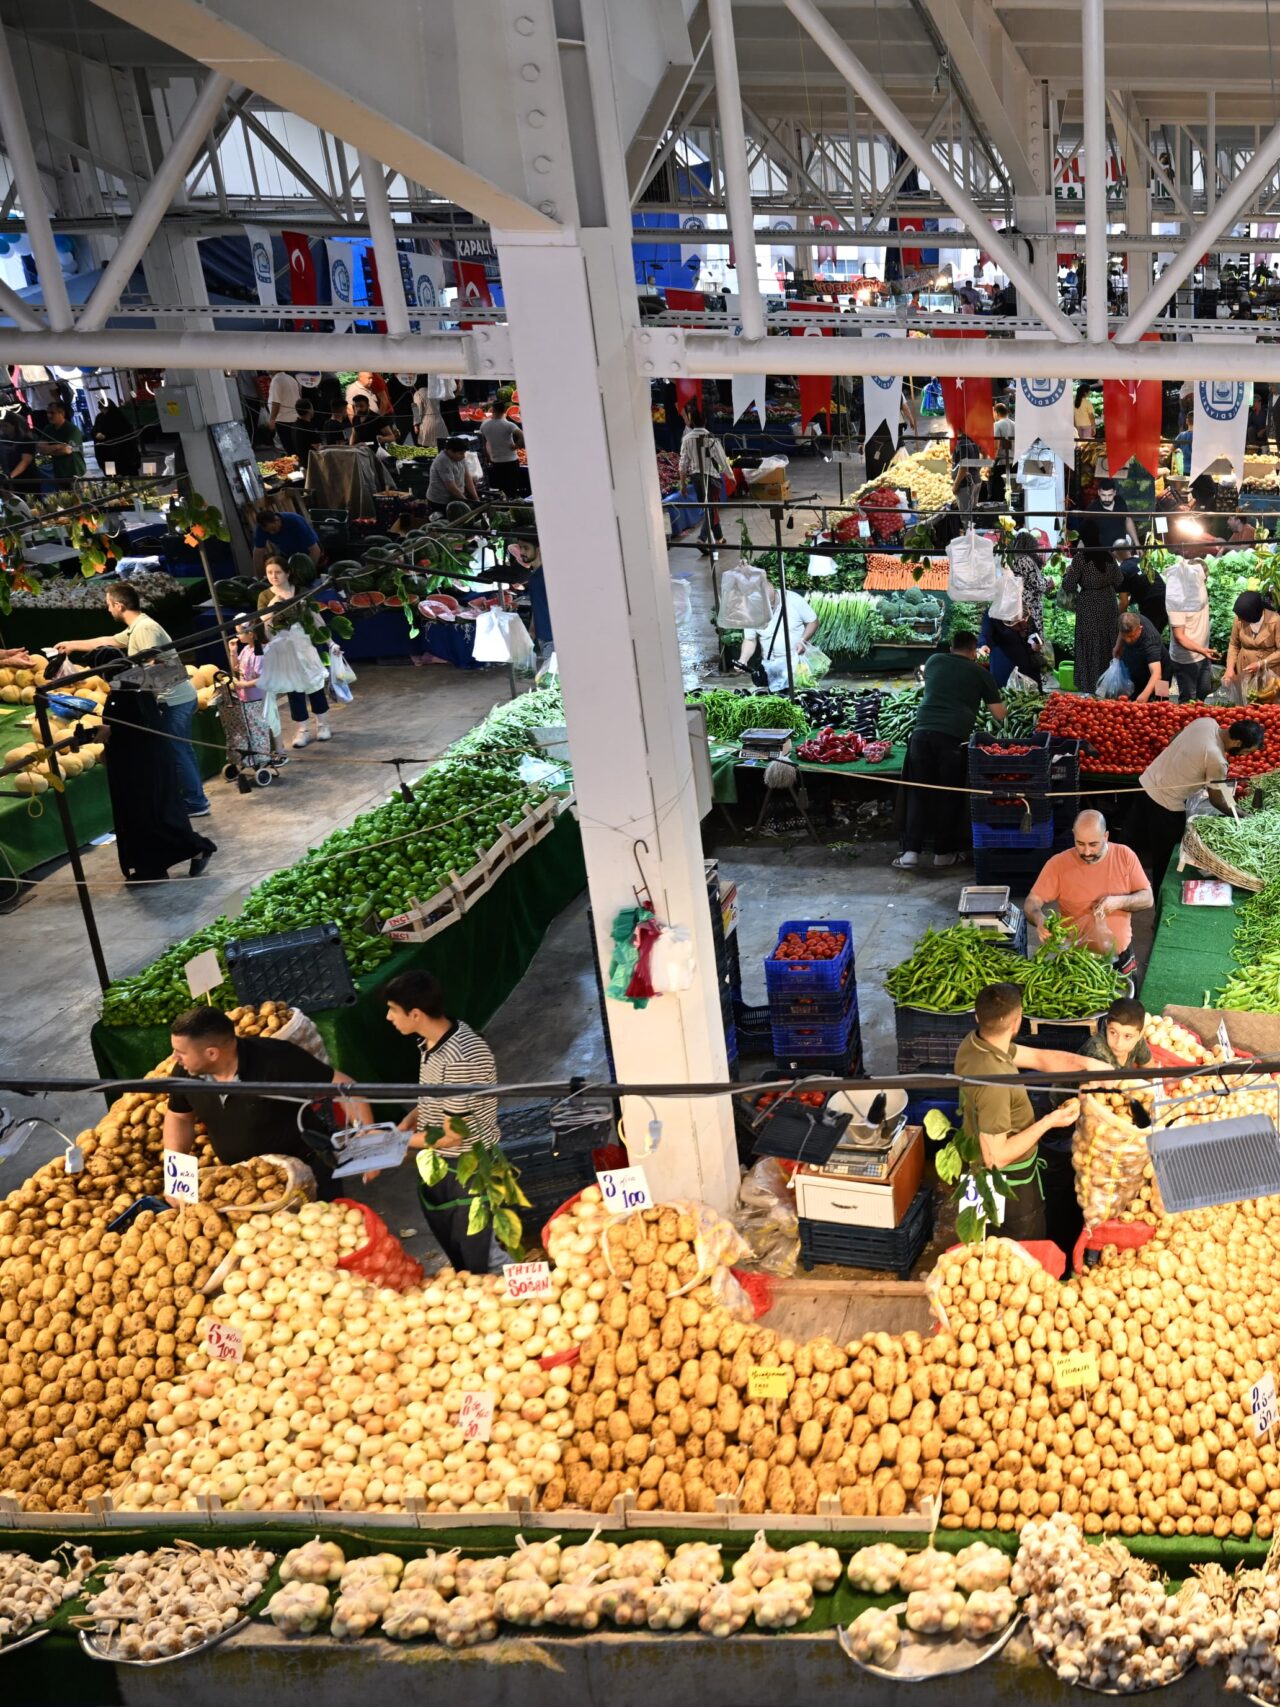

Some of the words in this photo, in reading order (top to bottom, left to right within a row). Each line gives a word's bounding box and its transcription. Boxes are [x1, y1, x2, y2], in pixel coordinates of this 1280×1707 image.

[456, 239, 491, 257] KAPALI
[171, 1179, 190, 1195] 100
[603, 1174, 616, 1198] 3
[622, 1189, 646, 1208] 100
[216, 1342, 237, 1359] 100
